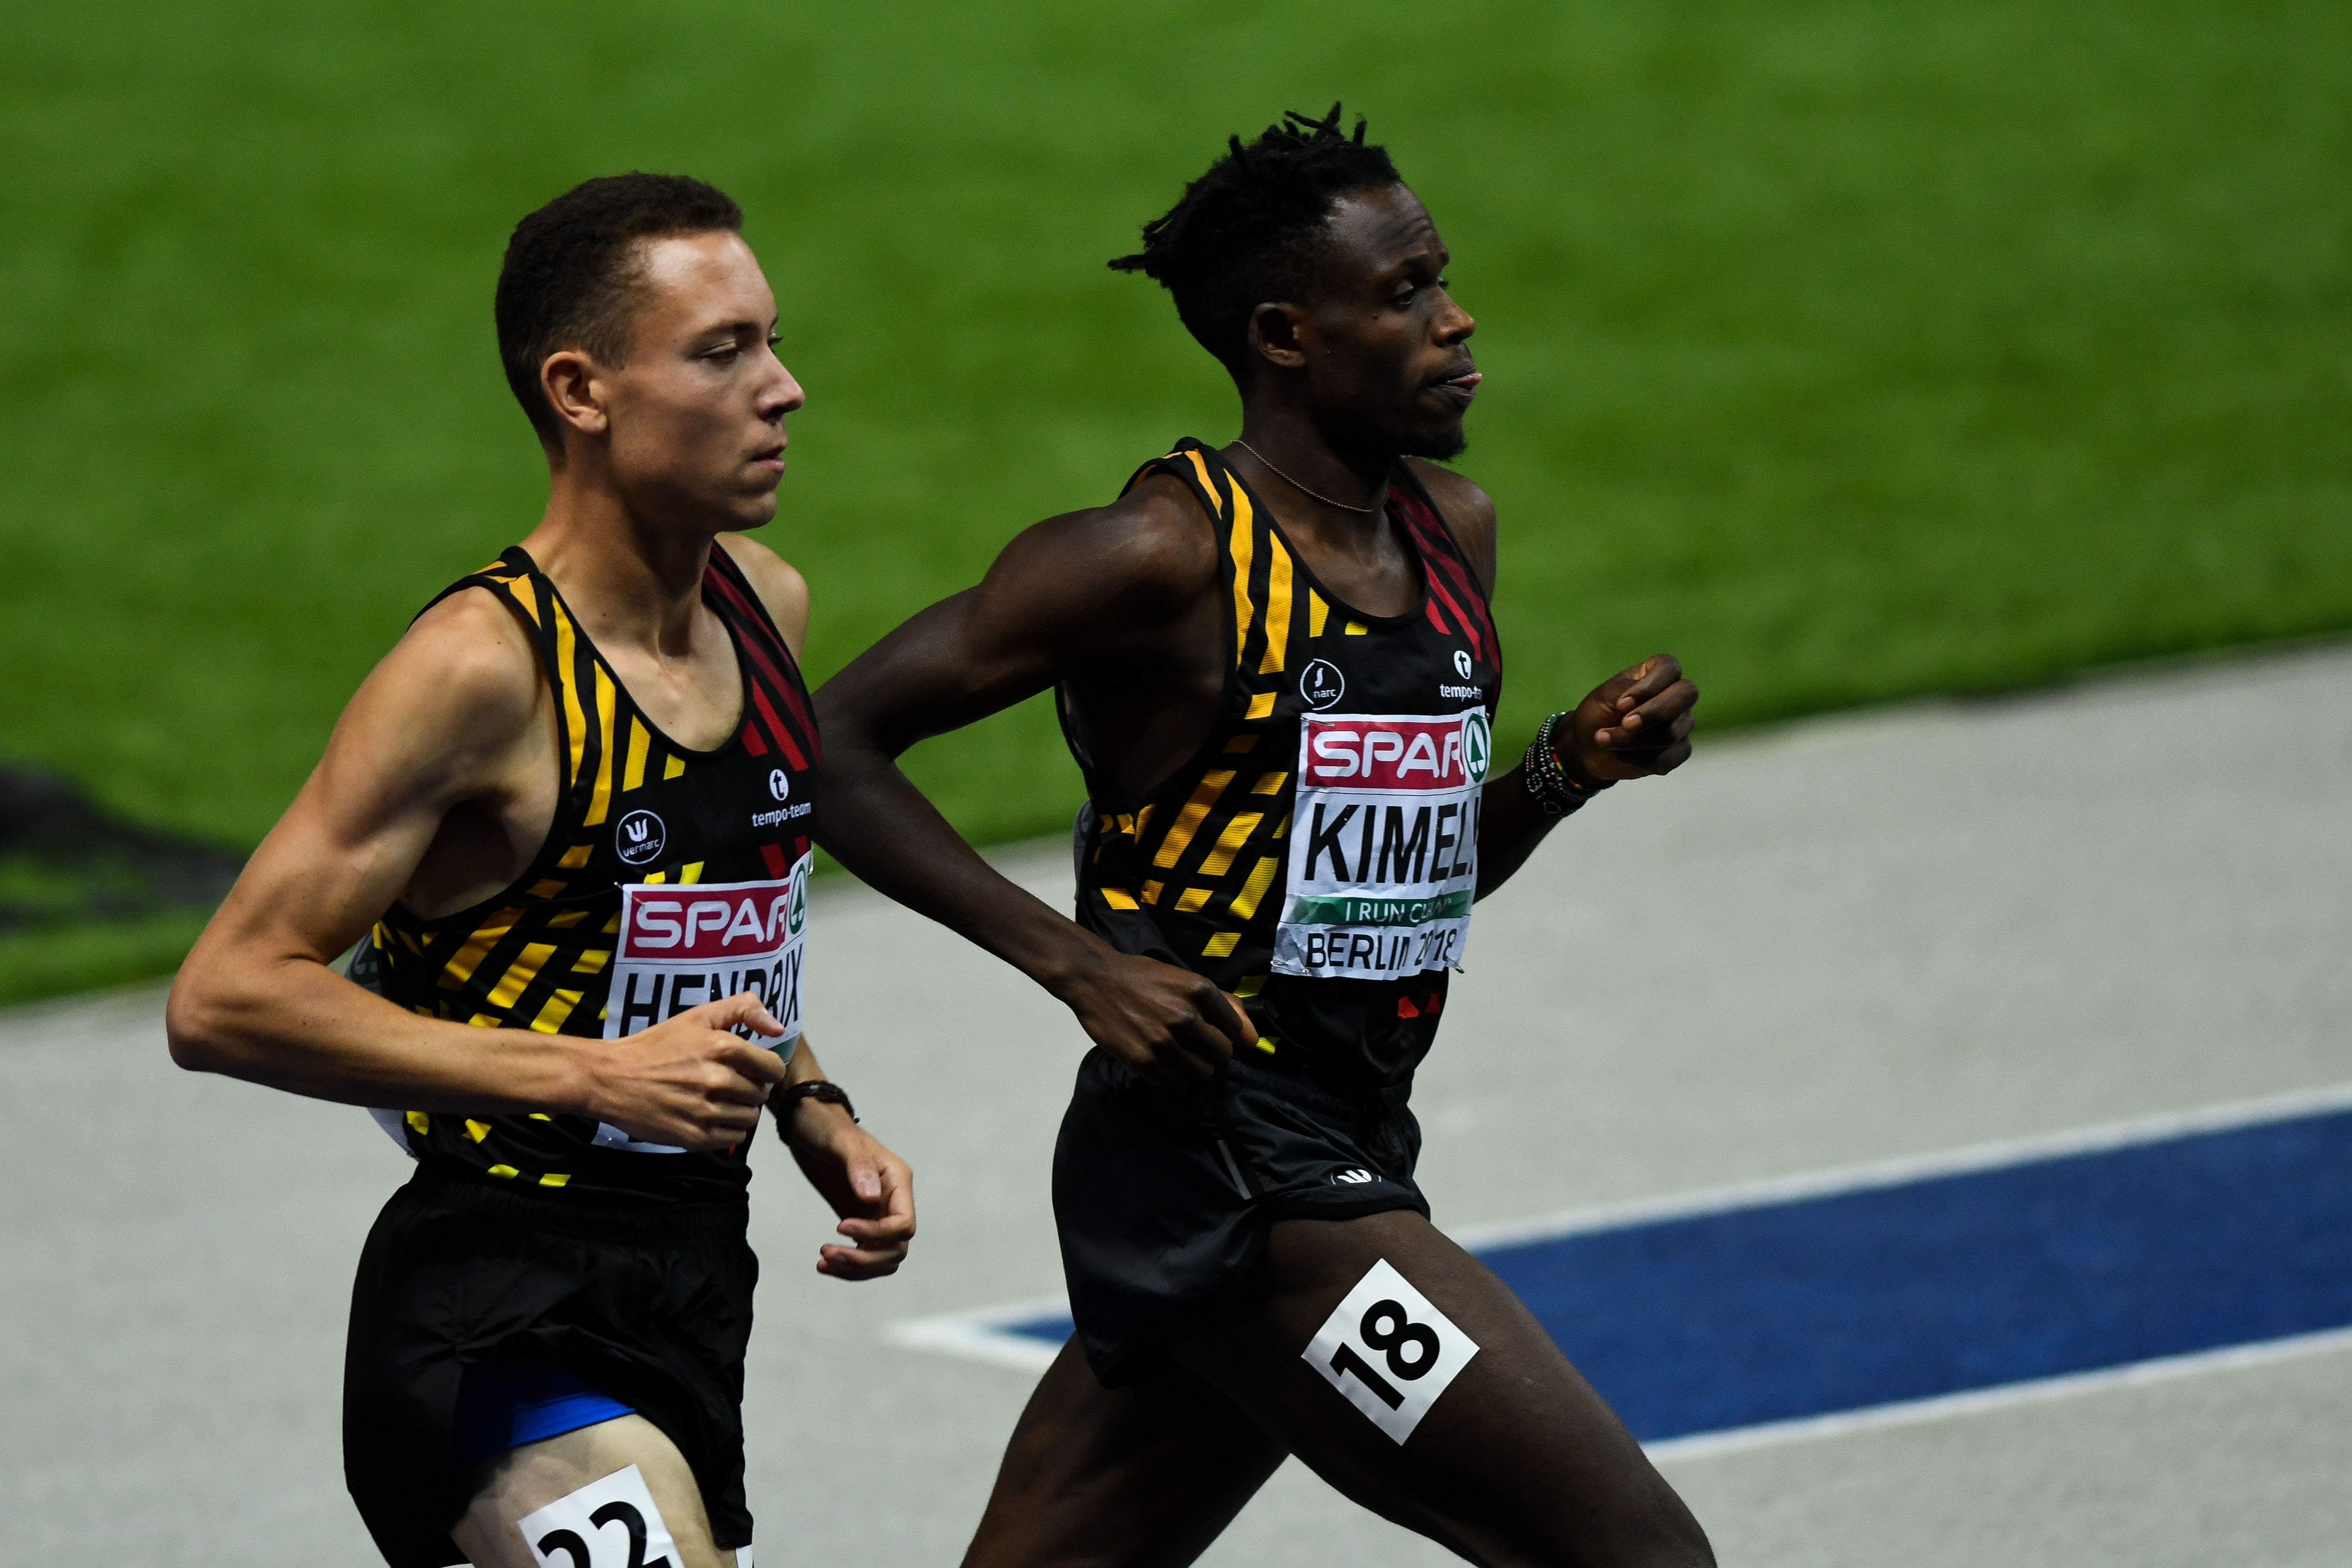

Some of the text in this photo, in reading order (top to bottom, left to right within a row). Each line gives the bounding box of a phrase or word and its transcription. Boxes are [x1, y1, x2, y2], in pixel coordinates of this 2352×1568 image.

[1313, 731, 1464, 778] SPAR
[752, 802, 811, 827] tempo-team
[623, 839, 660, 857] vermarc
[634, 893, 788, 948] SPAR
[1345, 901, 1351, 921] I
[1359, 902, 1405, 922] RUN
[1306, 933, 1410, 970] BERLIN
[1329, 1299, 1440, 1411] 18
